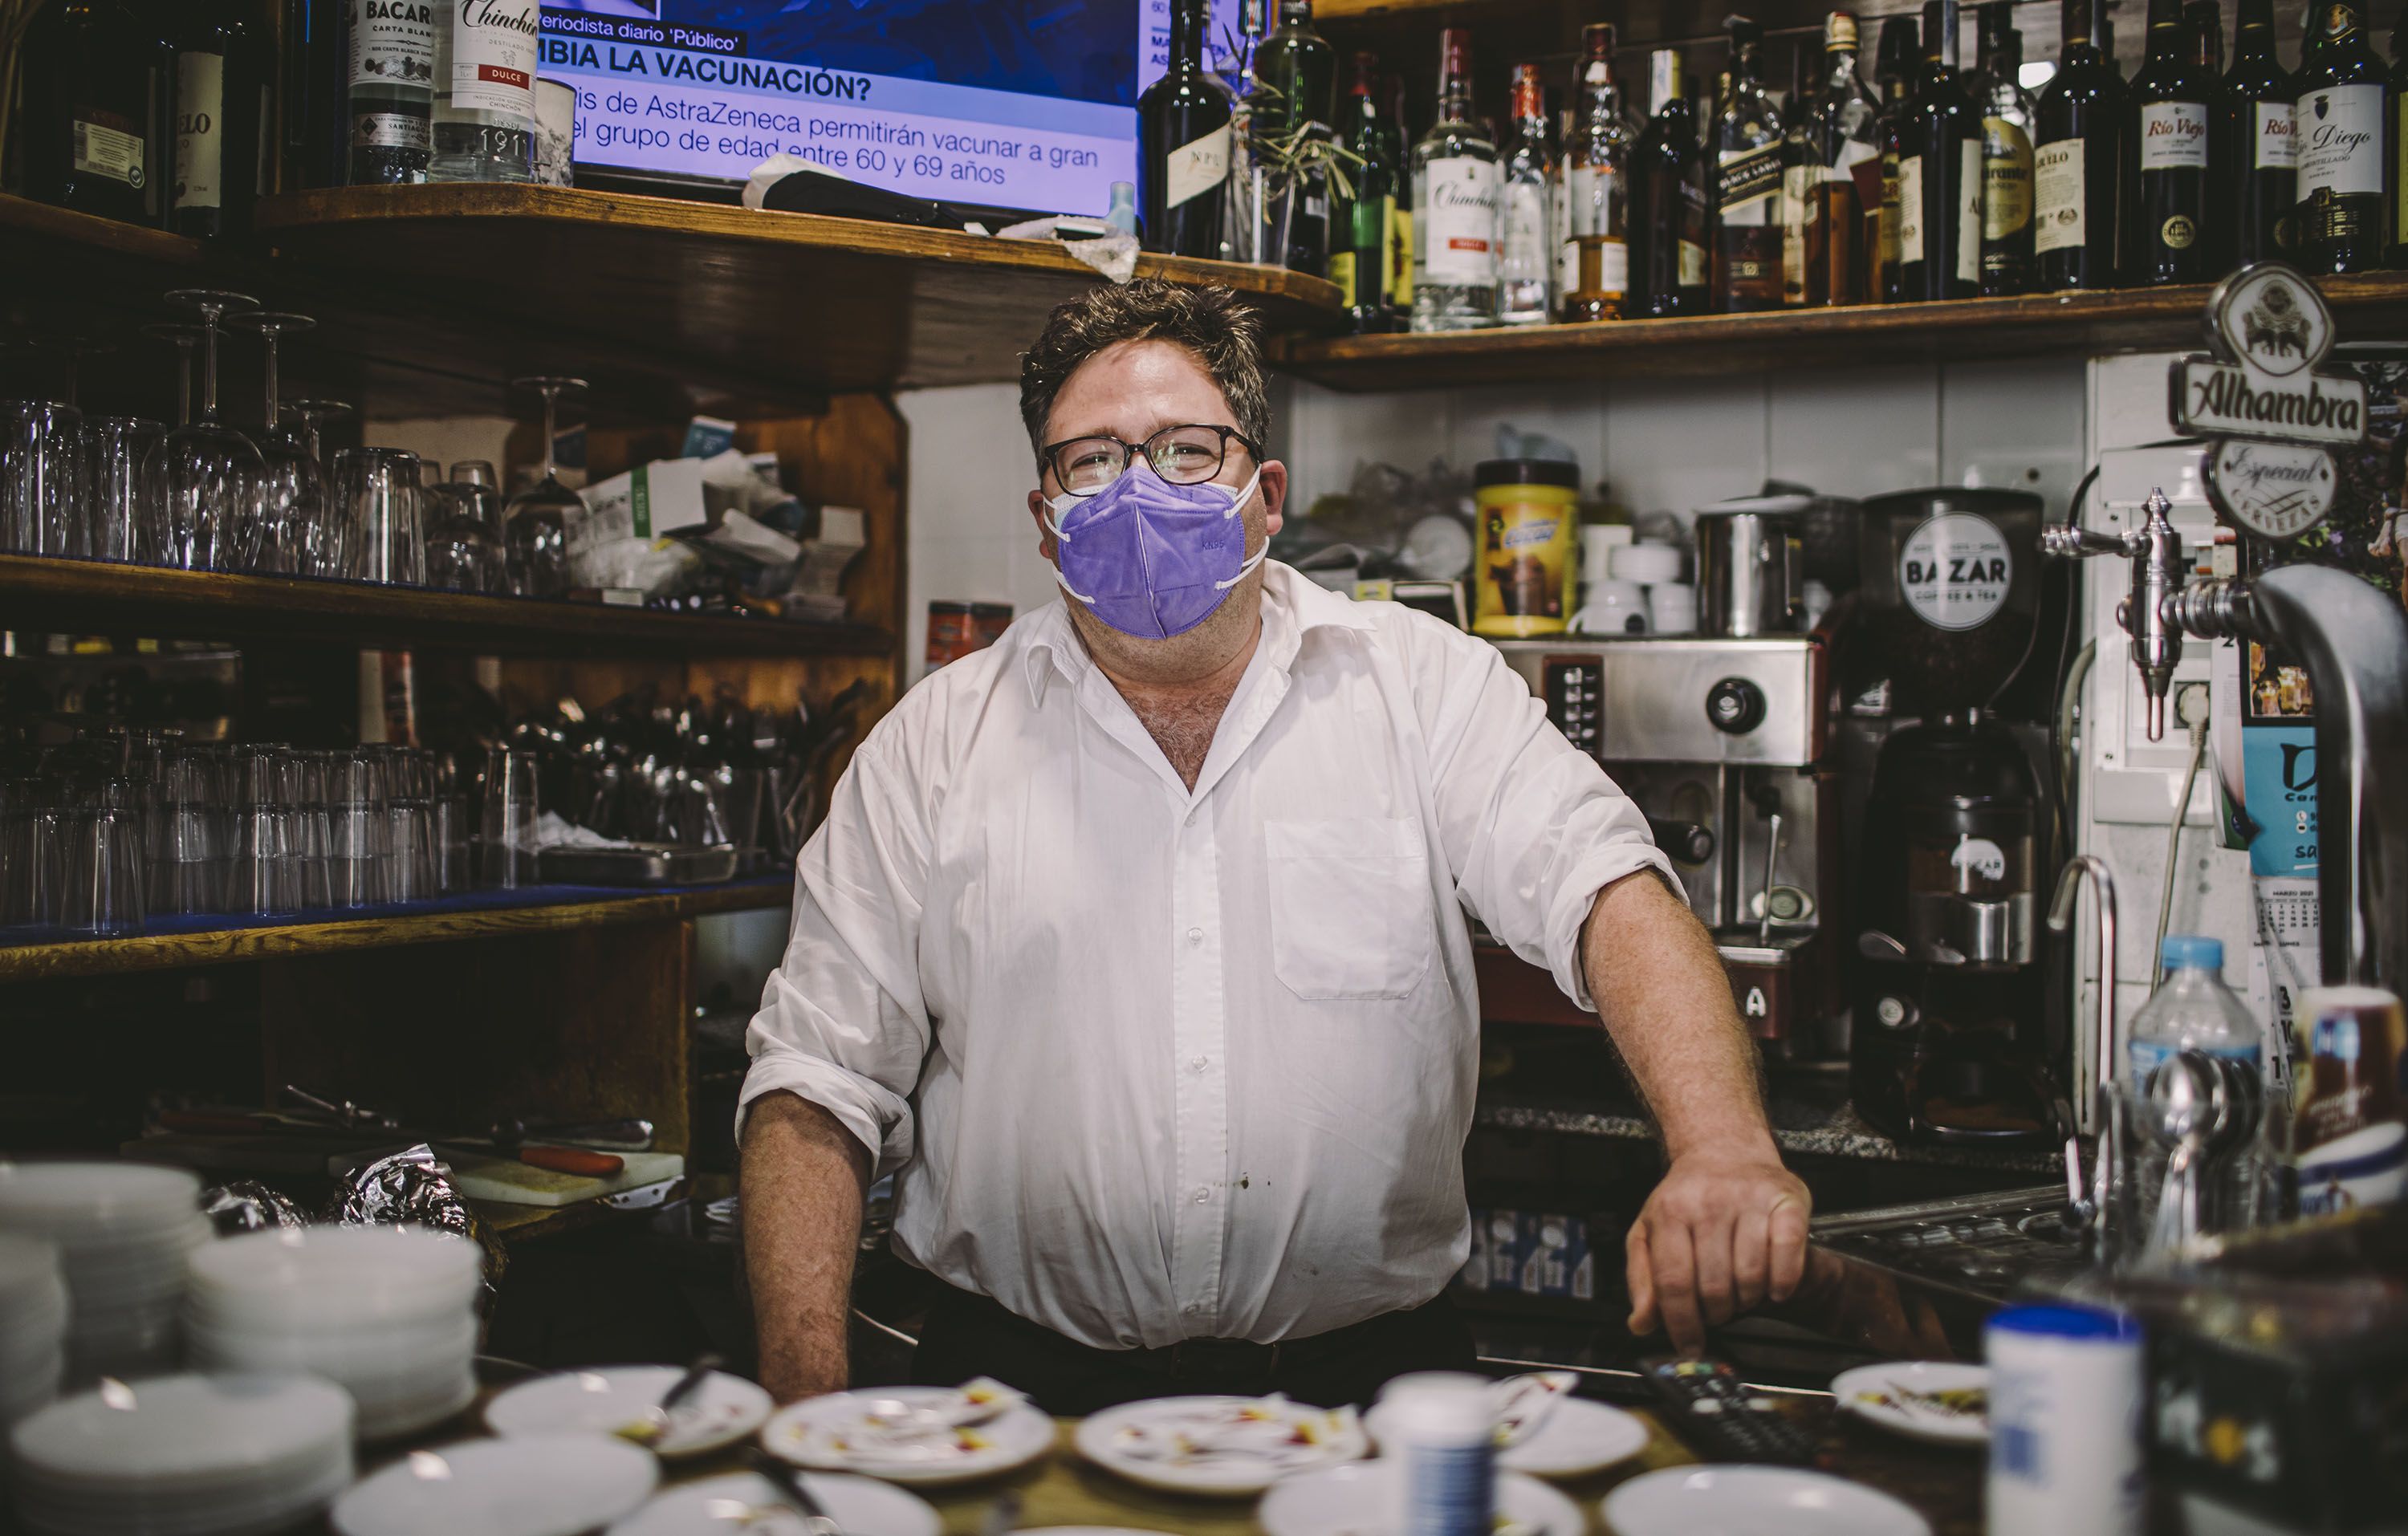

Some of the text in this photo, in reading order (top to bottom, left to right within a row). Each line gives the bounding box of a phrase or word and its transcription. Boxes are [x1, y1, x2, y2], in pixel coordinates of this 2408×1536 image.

[372, 25, 404, 33] CARTA
[618, 23, 664, 42] diario
[669, 28, 738, 51] 'Público'
[492, 69, 521, 82] DULCE
[609, 46, 648, 75] LA
[656, 51, 872, 101] VACUNACIÓN?
[388, 123, 425, 132] SANTIAGO
[573, 86, 1099, 169] is de AstraZeneca permitirán vacunar a gran
[2148, 119, 2174, 137] Río
[2312, 124, 2371, 153] Diego
[596, 122, 669, 150] grupo
[679, 129, 710, 152] de
[718, 136, 779, 156] edad
[788, 144, 848, 167] entre
[856, 148, 885, 171] 60
[893, 156, 907, 178] y
[913, 154, 943, 177] 69
[950, 161, 1006, 185] años
[2192, 370, 2359, 431] Alhambra
[2231, 445, 2327, 489] Especial
[1906, 558, 2006, 584] BAZAR
[1746, 985, 1767, 1017] A
